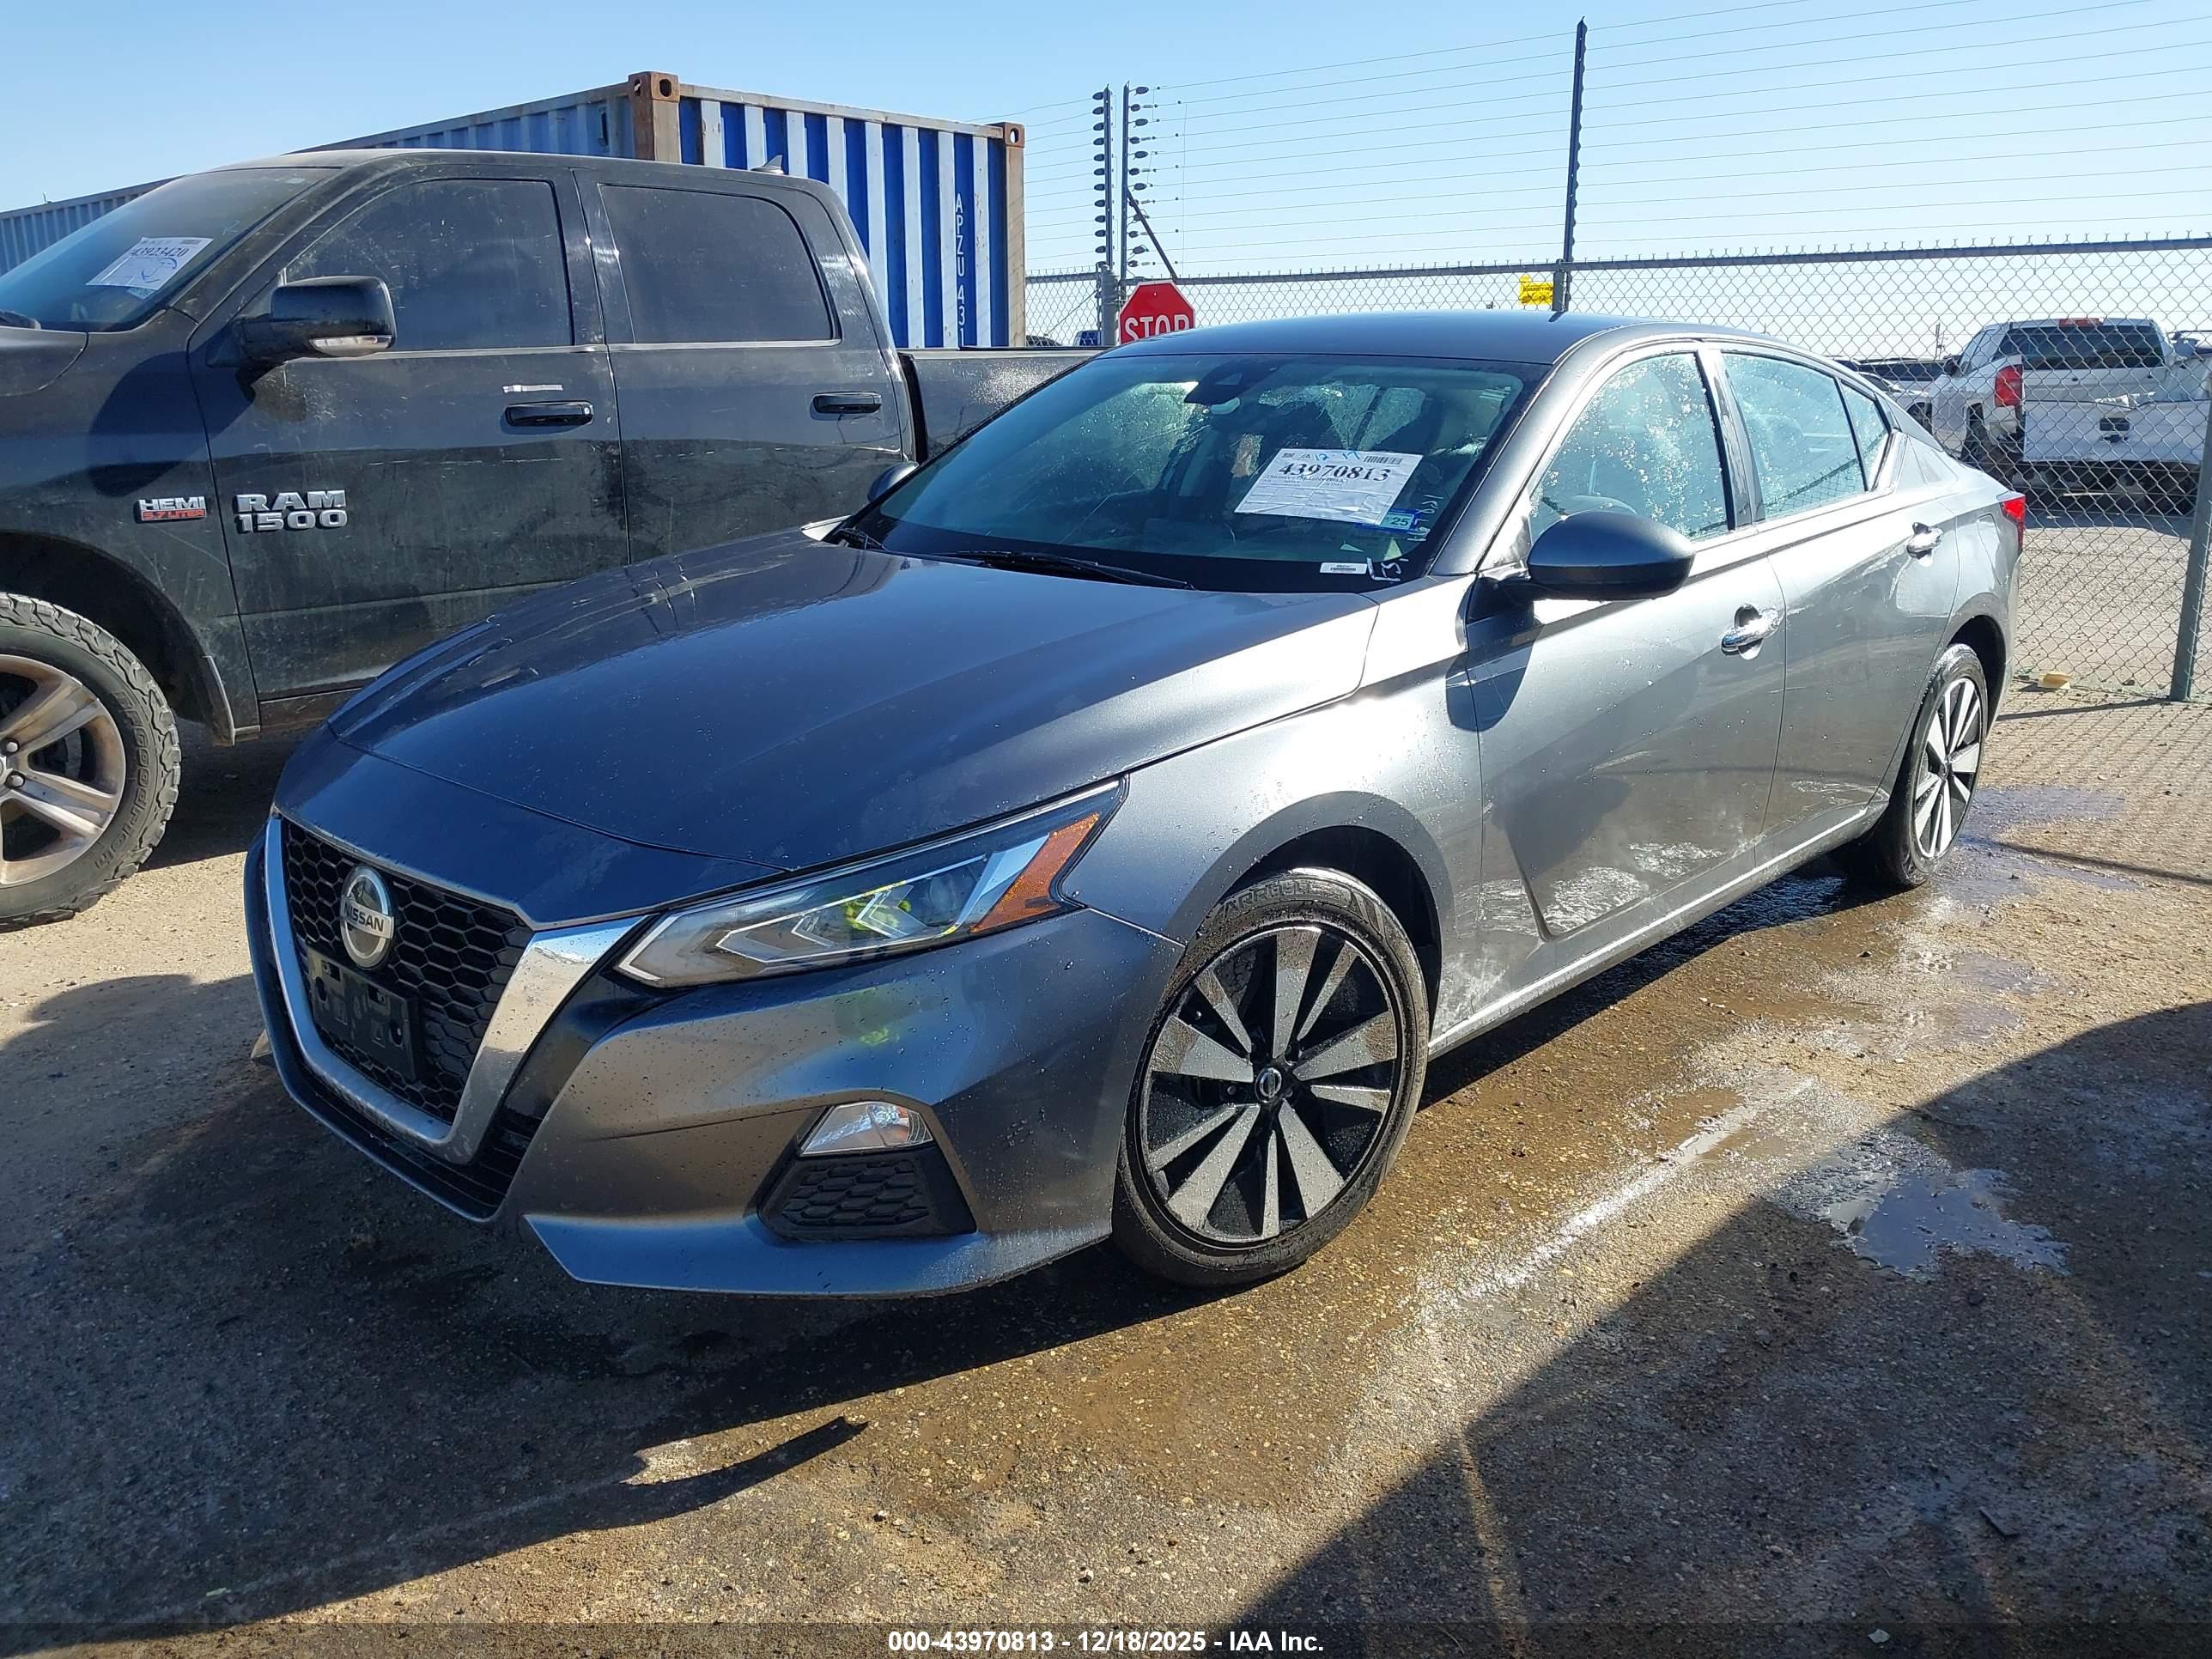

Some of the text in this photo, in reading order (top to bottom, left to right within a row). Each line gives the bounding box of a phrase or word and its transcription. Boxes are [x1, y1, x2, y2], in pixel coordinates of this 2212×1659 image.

[955, 192, 965, 277] APZU
[1125, 314, 1190, 341] STOP
[1279, 463, 1391, 481] 43970813
[138, 496, 205, 510] HEMI
[236, 489, 346, 513] RAM
[237, 509, 349, 532] 1500
[344, 898, 385, 933] NISSAN
